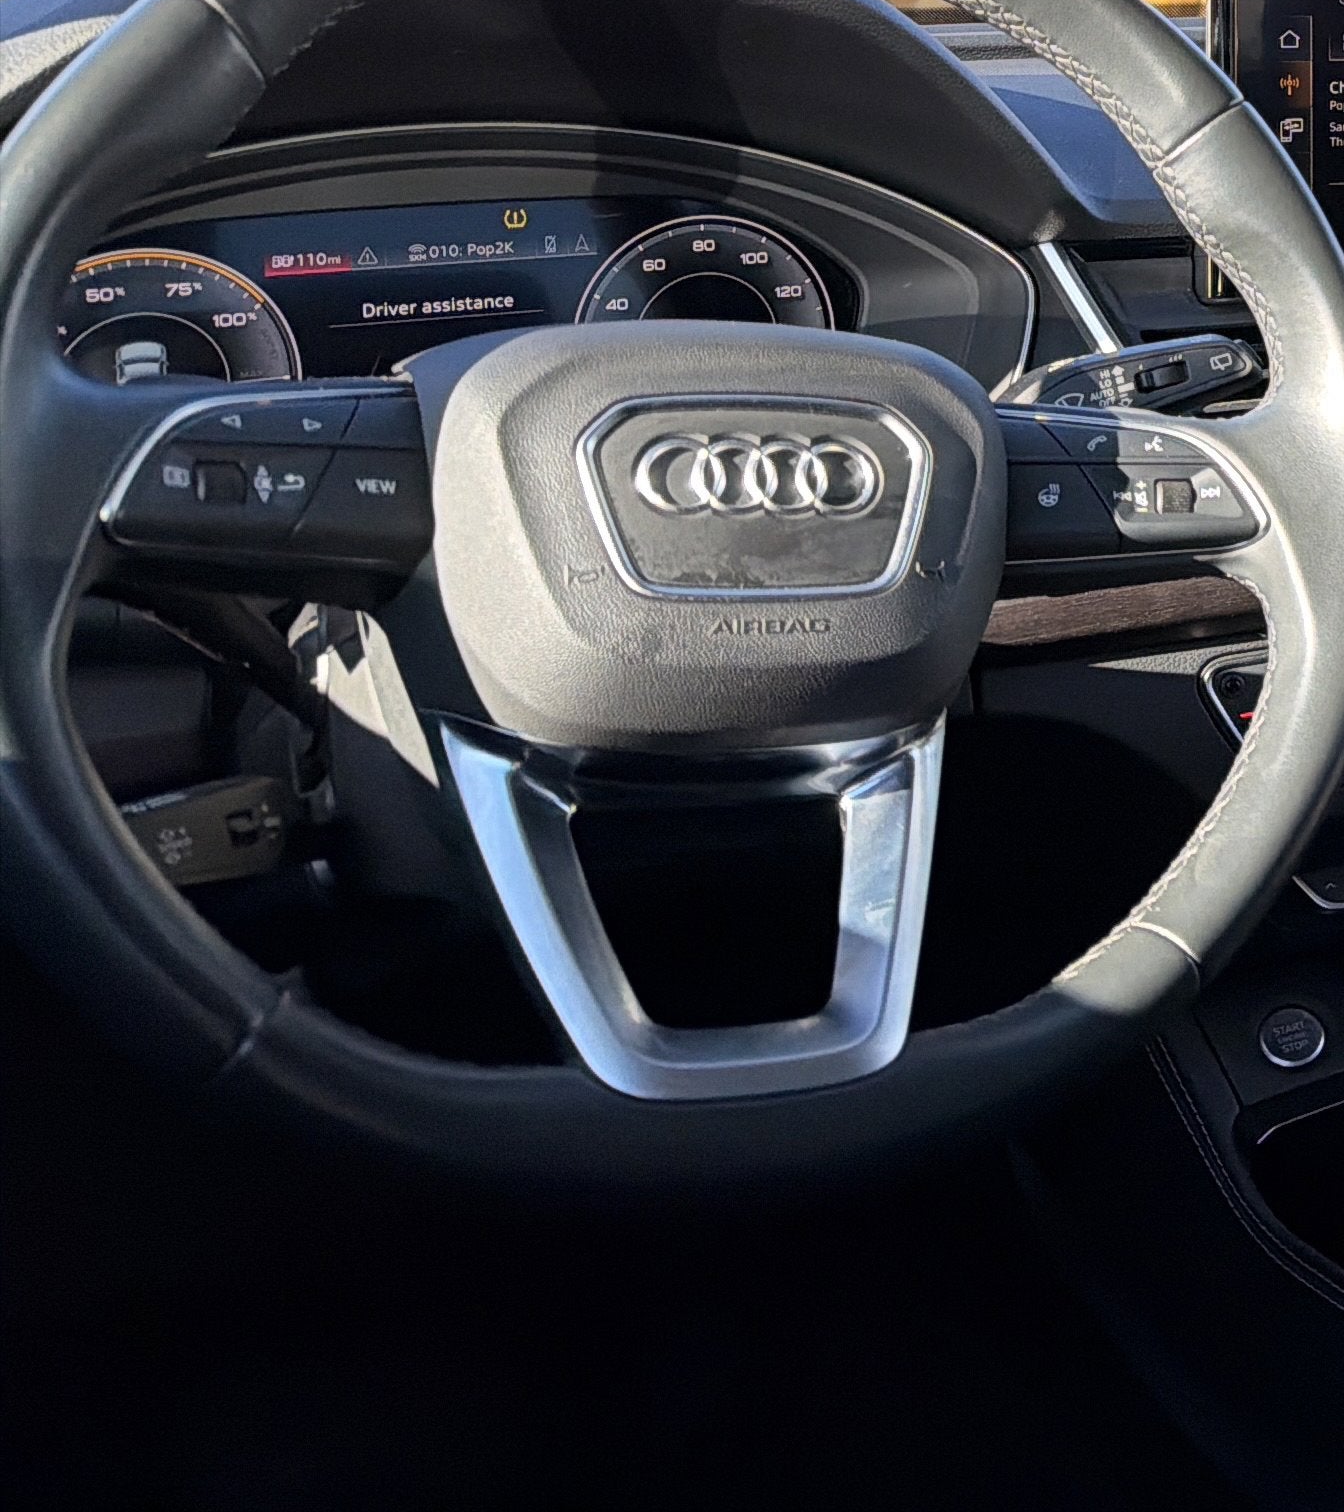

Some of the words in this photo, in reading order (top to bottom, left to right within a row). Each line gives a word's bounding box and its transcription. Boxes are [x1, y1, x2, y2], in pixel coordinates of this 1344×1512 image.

[428, 245, 463, 259] 010:
[467, 241, 515, 257] Pop2K
[692, 238, 716, 252] 80
[642, 258, 666, 272] 60
[739, 251, 769, 265] 100
[85, 286, 126, 303] 50%
[164, 281, 203, 298] 75%
[774, 284, 802, 298] 120
[362, 301, 418, 319] Driver
[422, 295, 514, 315] assistance
[605, 298, 629, 311] 40
[212, 311, 258, 328] 100%
[1099, 379, 1113, 390] LO
[1090, 388, 1115, 402] AUTO
[355, 478, 397, 495] VIEW
[708, 617, 832, 635] AIRBAG
[1272, 1020, 1305, 1037] START
[1280, 1039, 1309, 1054] STOP
